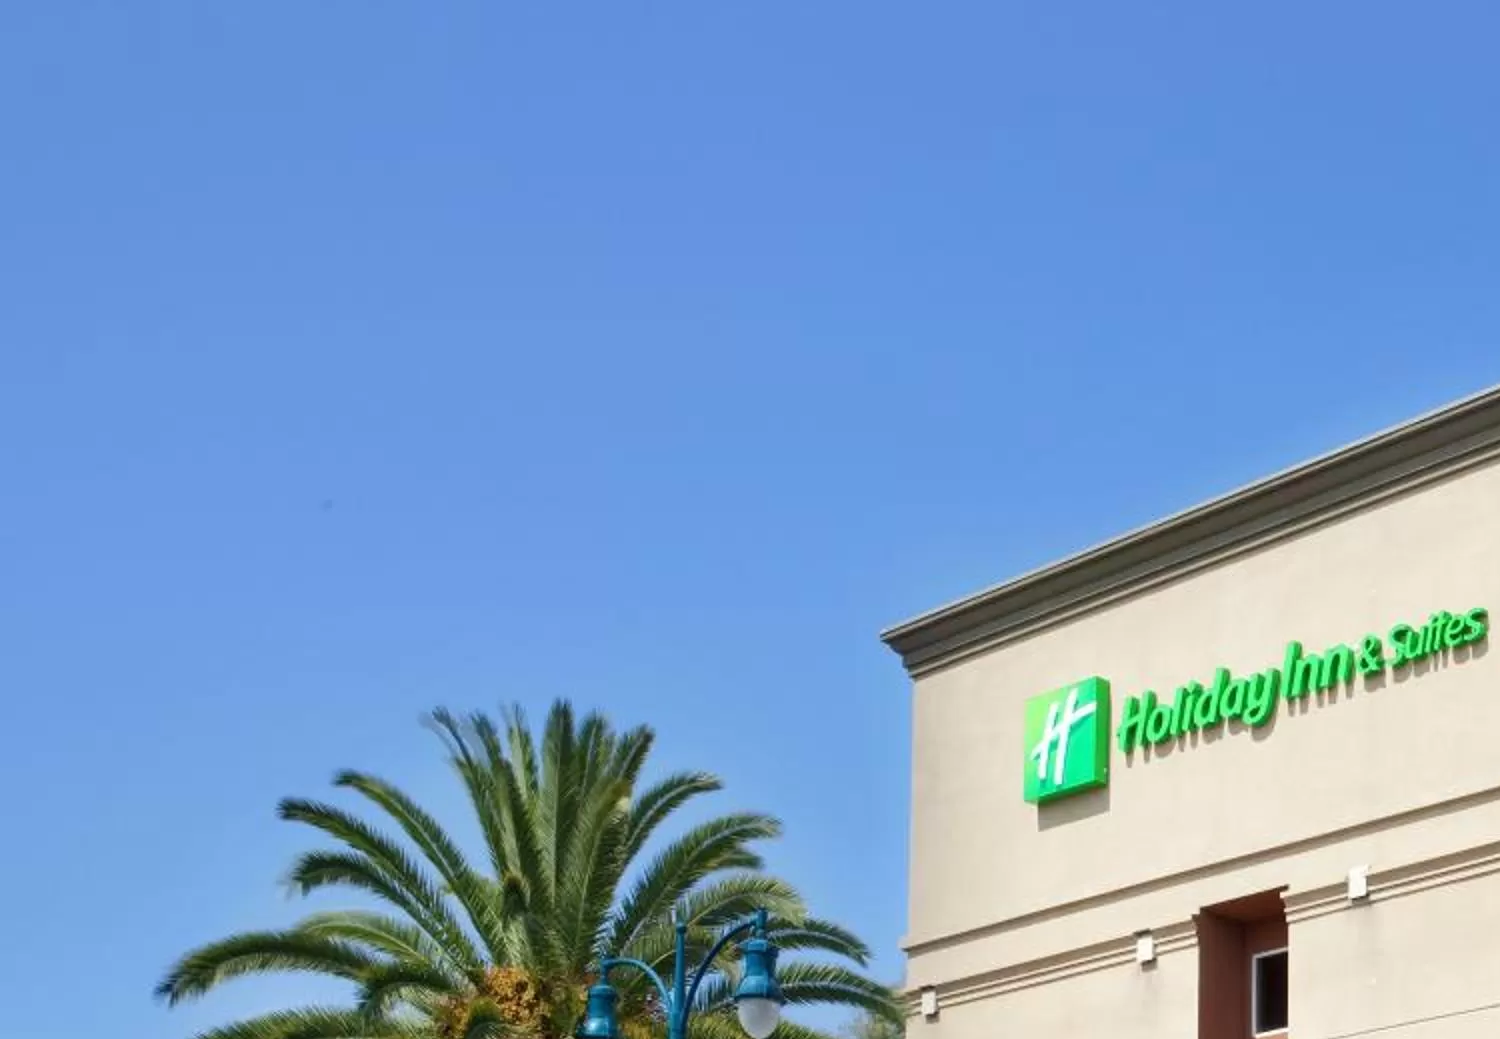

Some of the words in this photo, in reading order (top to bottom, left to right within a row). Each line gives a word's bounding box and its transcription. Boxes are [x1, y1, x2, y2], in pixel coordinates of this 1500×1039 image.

[1117, 667, 1281, 754] Holiday
[1282, 640, 1355, 699] Inn
[1357, 634, 1385, 676] &
[1387, 607, 1489, 668] Suites
